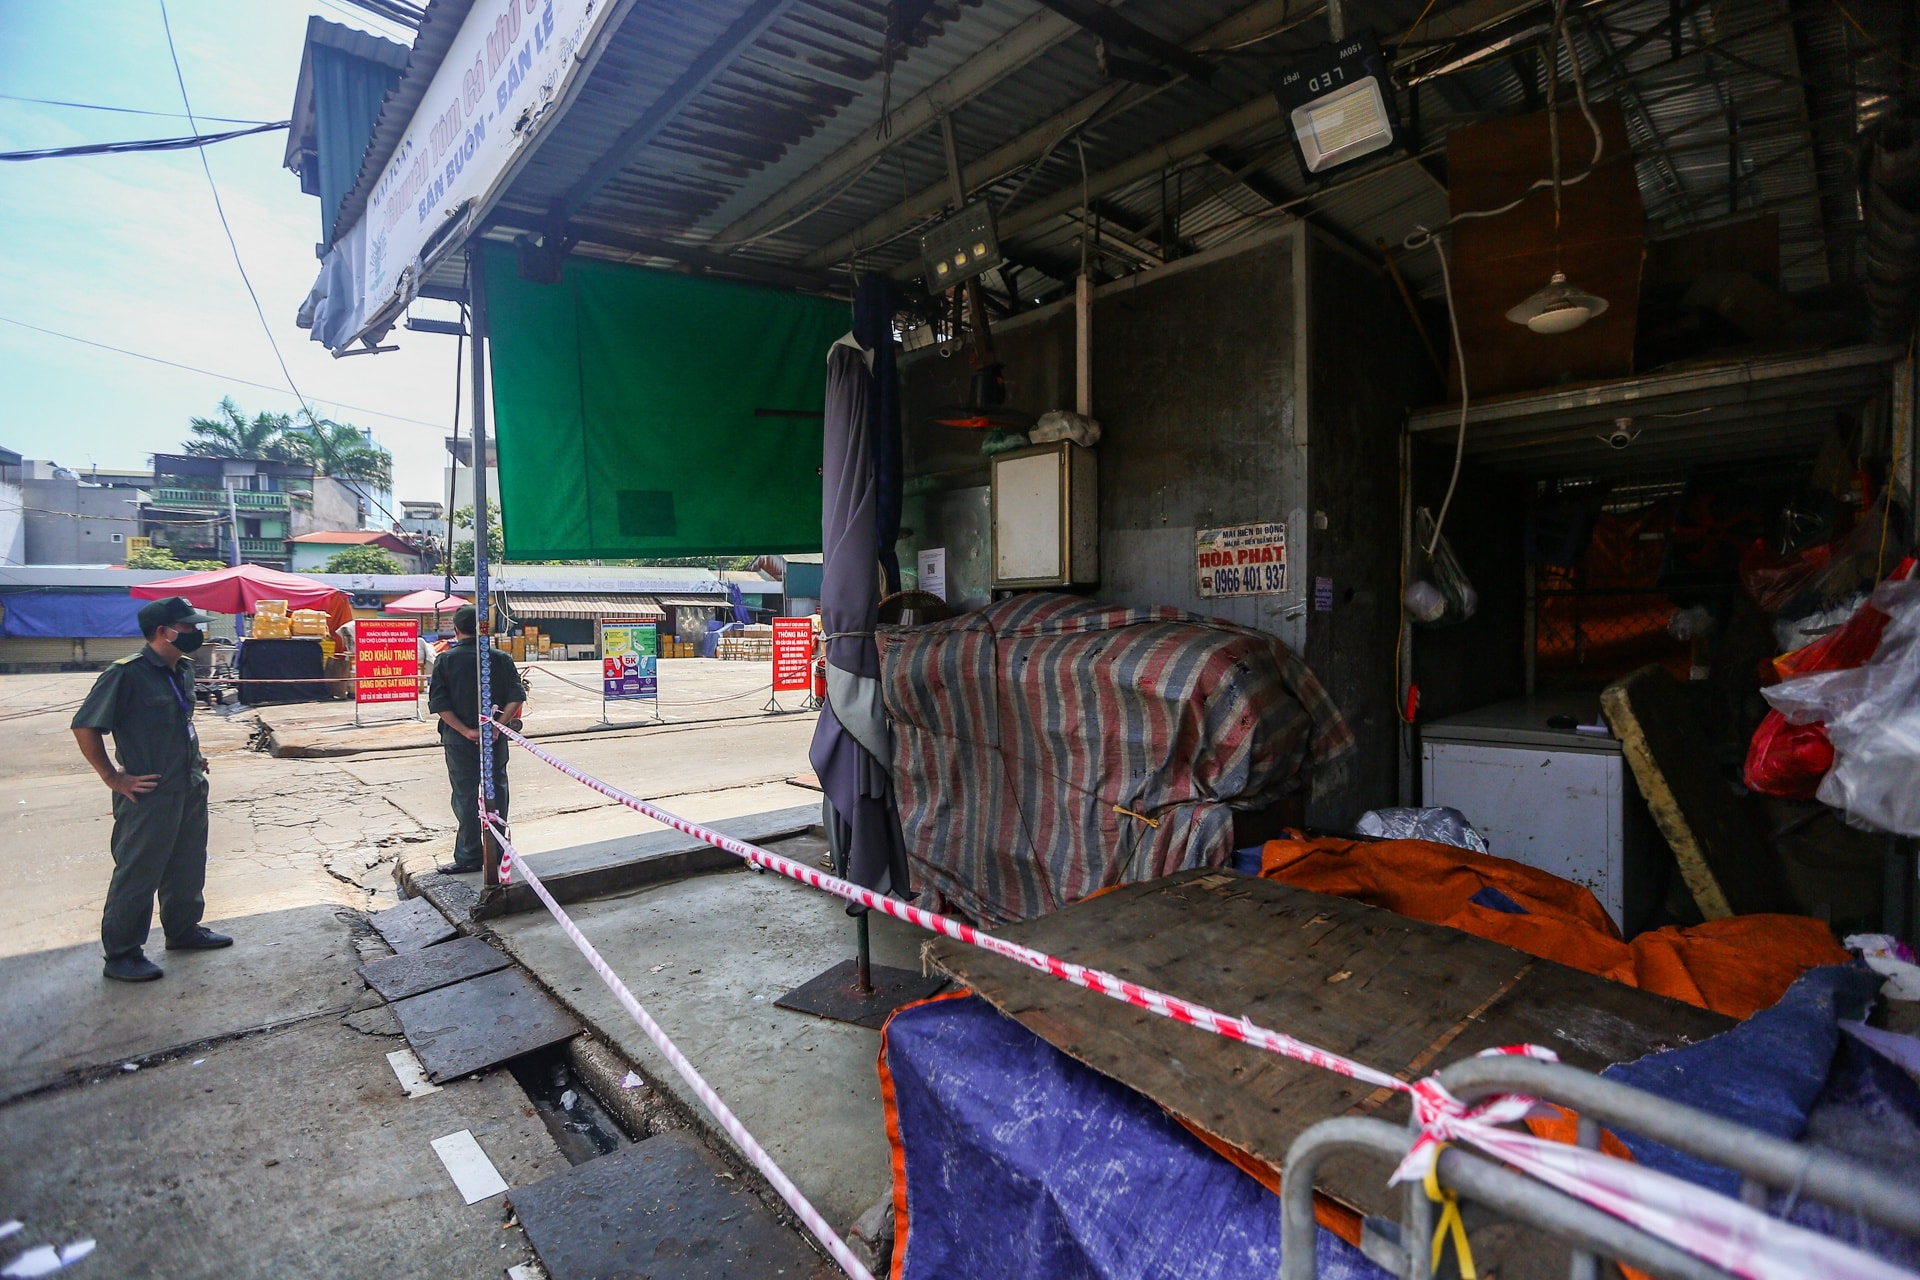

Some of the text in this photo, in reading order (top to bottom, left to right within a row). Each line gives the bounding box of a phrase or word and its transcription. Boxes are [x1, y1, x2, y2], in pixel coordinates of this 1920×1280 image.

[1339, 42, 1363, 60] 150W
[1283, 71, 1300, 85] IP67
[1308, 66, 1344, 92] LED
[430, 97, 462, 168] Tôm
[462, 49, 486, 117] Cá
[418, 172, 445, 224] BÁN
[445, 114, 486, 189] BUÔN
[496, 39, 533, 115] BÁN
[1199, 543, 1285, 568] HÒA PHÁT
[543, 580, 614, 590] TRANG
[1214, 563, 1286, 593] 0966 401 937
[777, 629, 808, 638] THÔNG BÁO
[359, 643, 416, 662] ĐEO KHẨU TRANG
[392, 667, 403, 675] TAY
